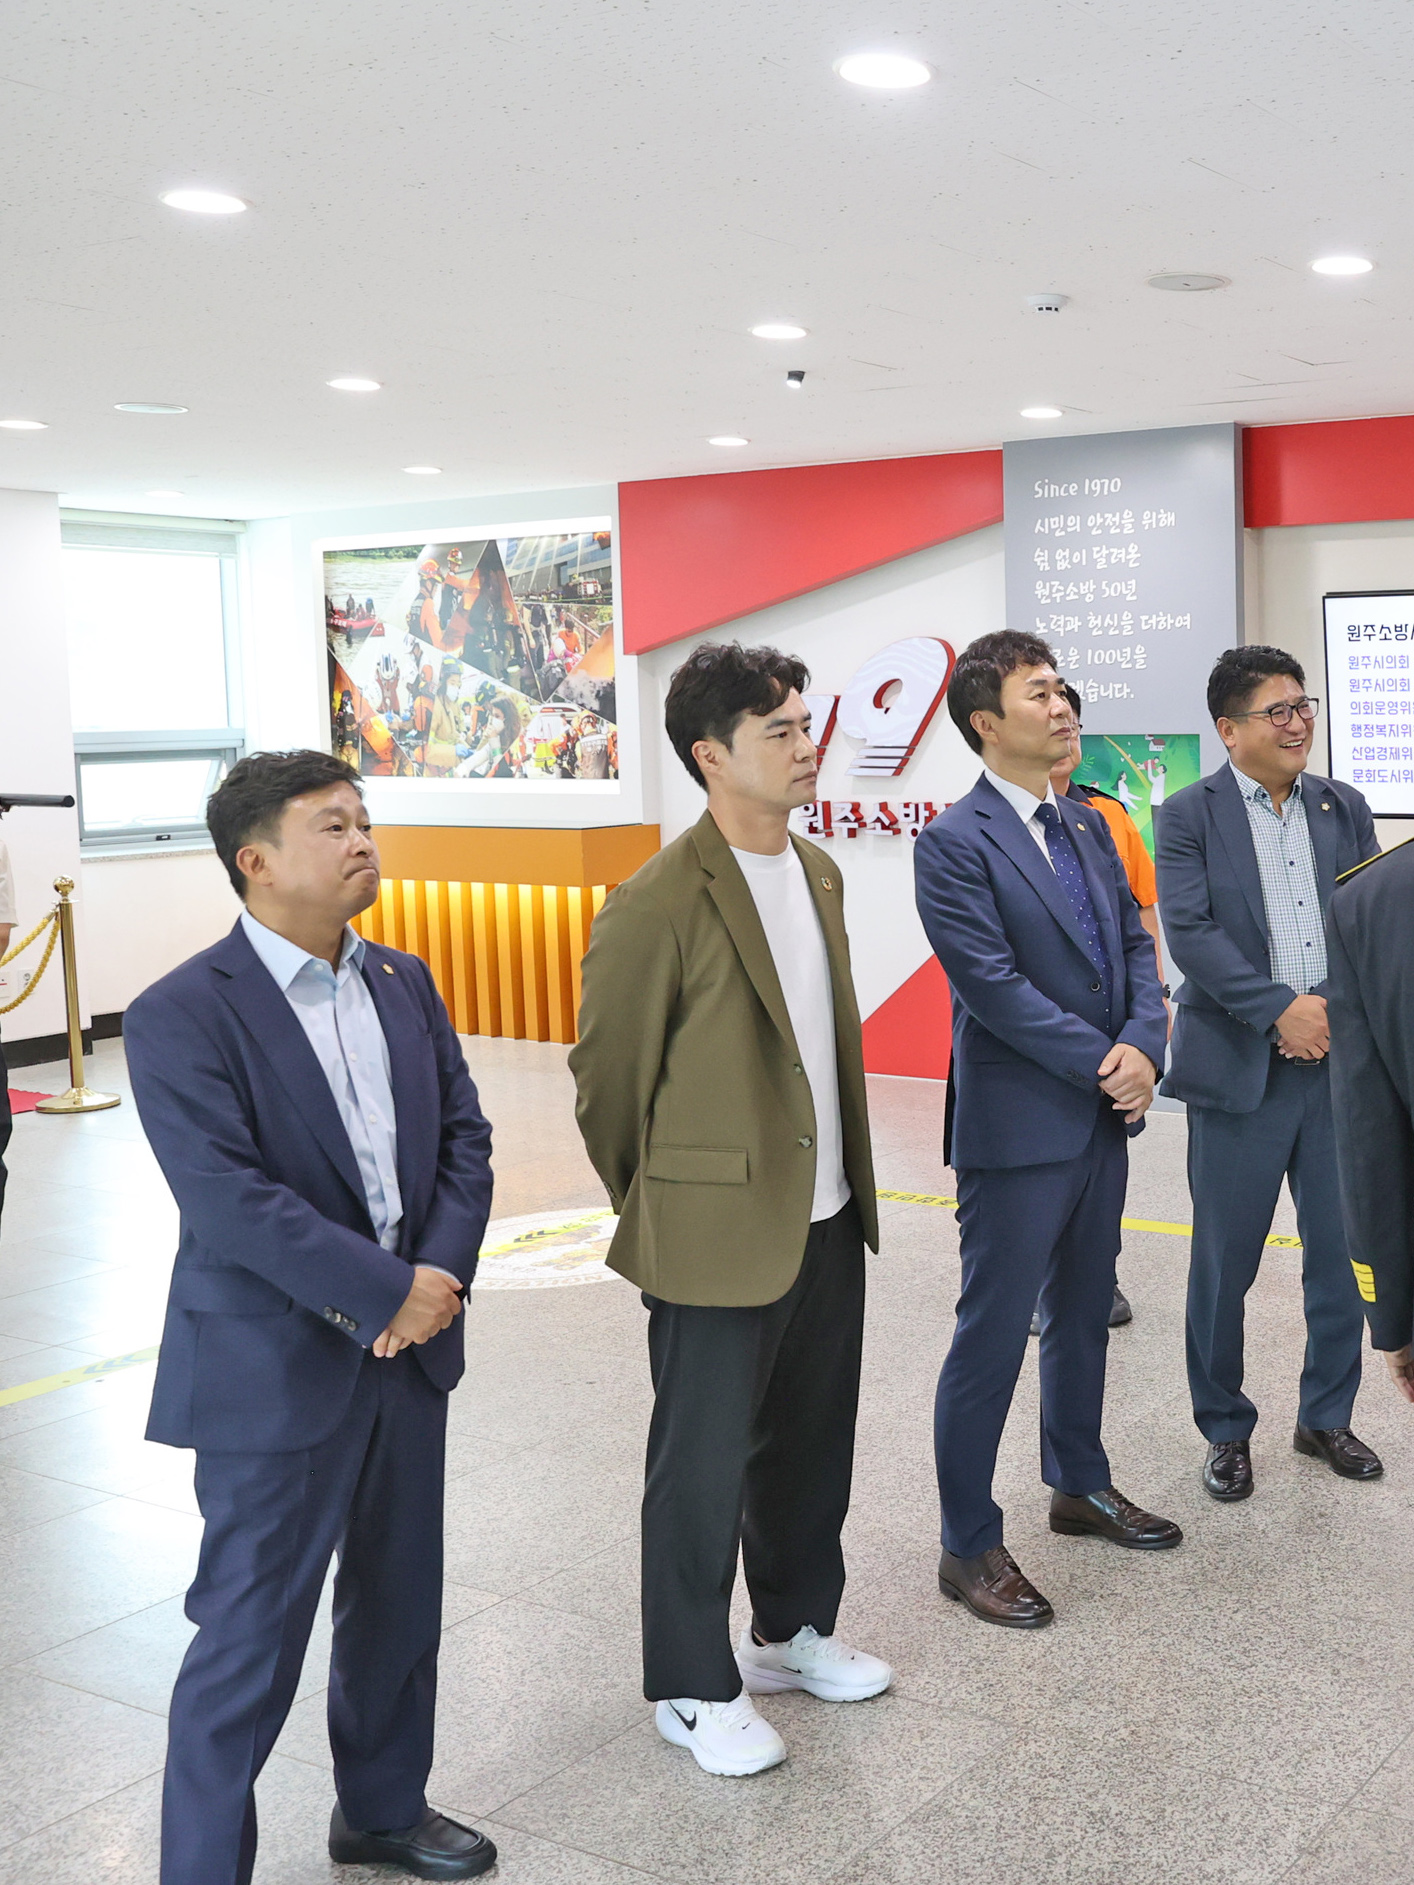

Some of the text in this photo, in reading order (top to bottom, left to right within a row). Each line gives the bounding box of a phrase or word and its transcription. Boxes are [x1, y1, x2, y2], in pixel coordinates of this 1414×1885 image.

[1034, 477, 1122, 499] Since 1970
[1035, 508, 1176, 537] 시민의 안전을 위해
[1033, 543, 1141, 571] 쉼 없이 달려온
[1034, 579, 1138, 604] 원주소방 50년
[1035, 611, 1191, 637] 노력과 헌신을 더하여
[1086, 644, 1147, 670] 100년을
[1348, 654, 1410, 670] 원주시의회
[1349, 677, 1411, 693] 원주시의회
